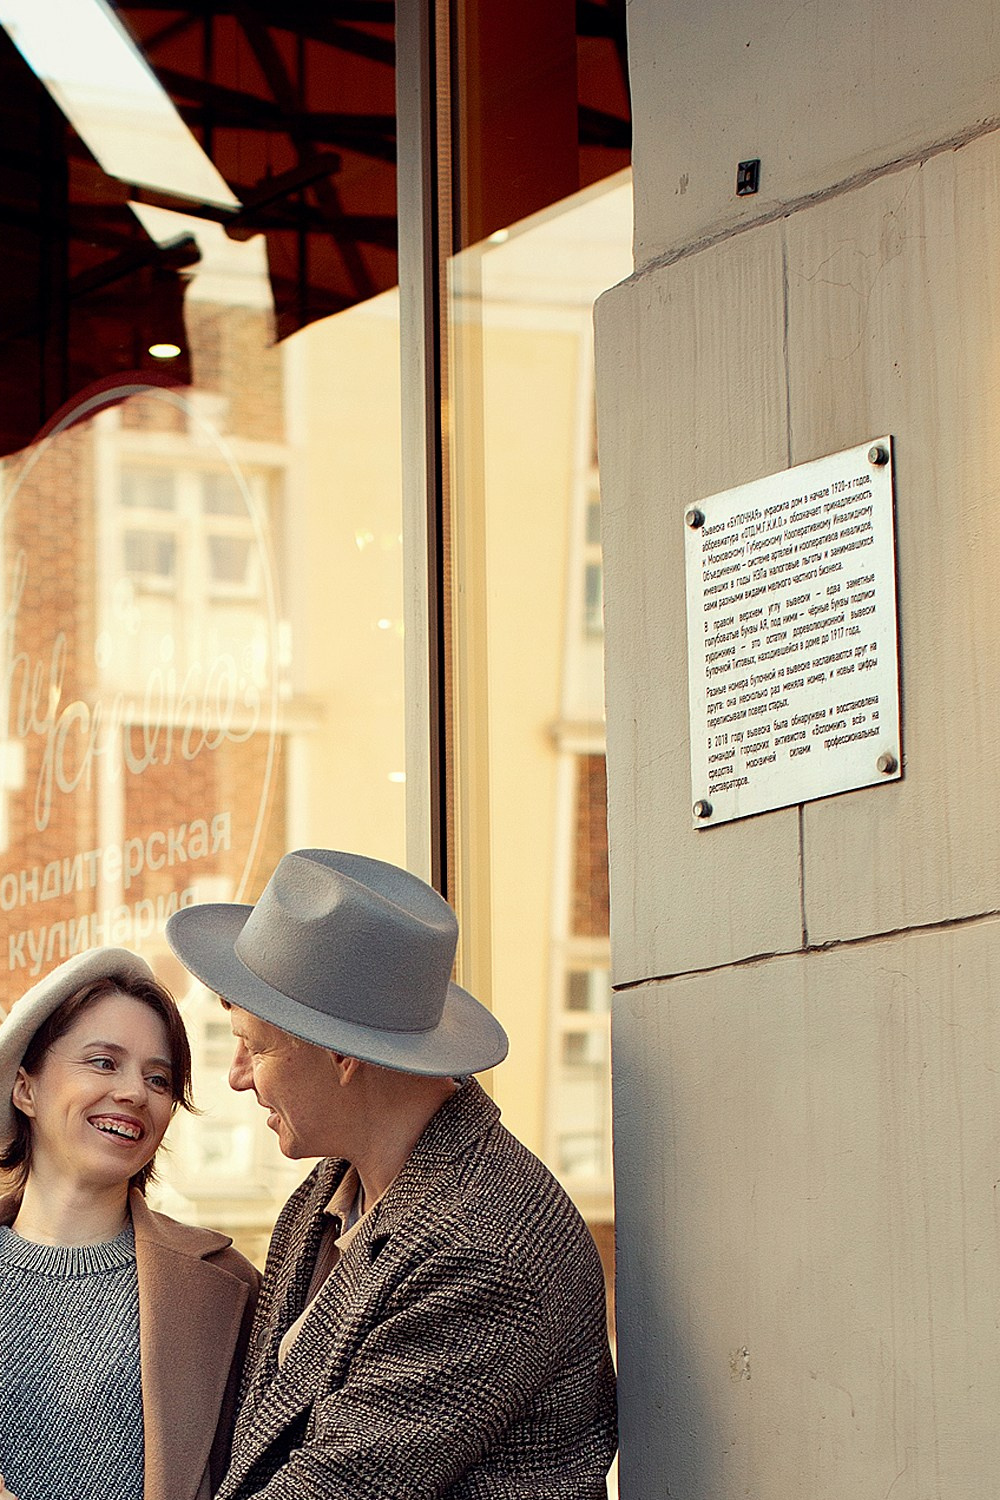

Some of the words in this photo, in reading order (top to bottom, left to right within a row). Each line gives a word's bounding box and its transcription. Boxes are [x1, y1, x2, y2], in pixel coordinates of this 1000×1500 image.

[701, 523, 725, 538] Вывеска
[727, 508, 762, 528] «БУЛОЧНАЯ»
[764, 501, 789, 519] украсила
[791, 497, 803, 509] дом
[810, 488, 829, 501] начале
[831, 480, 851, 494] 1920-х
[702, 533, 739, 552] аббревиатура
[790, 506, 822, 524] обозначает
[823, 490, 872, 512] принадлежность
[708, 547, 745, 564] Московскому
[746, 534, 782, 555] Губернскому
[784, 519, 831, 540] Кооперативному
[833, 505, 873, 525] Инвалидному
[703, 563, 741, 582] Объединению
[748, 553, 770, 568] системе
[771, 543, 793, 562] артелей
[799, 531, 838, 551] кооперативов
[840, 521, 873, 538] инвалидов,
[703, 582, 728, 596] имевших
[736, 575, 751, 586] годы
[753, 567, 767, 581] НЭПа
[769, 559, 800, 576] налоговые
[802, 553, 822, 566] льготы
[830, 536, 874, 557] занимавшихся
[704, 600, 718, 612] сами
[719, 592, 744, 610] разными
[745, 585, 766, 599] видами
[767, 577, 791, 592] мелкого
[792, 569, 818, 584] частного
[713, 616, 734, 631] правом
[739, 608, 763, 622] верхнем
[768, 602, 781, 616] углу
[786, 593, 811, 608] вывески
[826, 584, 841, 595] едва
[846, 573, 875, 590] заметные
[704, 630, 739, 647] голубоватые
[741, 624, 758, 639] буквы
[770, 617, 781, 627] под
[783, 612, 798, 624] ними
[808, 602, 829, 617] чёрные
[831, 597, 849, 612] буквы
[851, 589, 876, 603] подписи
[751, 639, 761, 649] это
[766, 631, 787, 644] остатки
[793, 611, 845, 638] дореволюционной
[851, 605, 876, 620] вывески
[706, 660, 731, 679] булочной
[732, 656, 756, 669] Титовых,
[758, 642, 799, 661] находившейся
[805, 636, 820, 650] доме
[821, 634, 829, 645] до
[830, 626, 844, 640] 1917
[706, 685, 726, 698] Разные
[728, 678, 749, 692] номера
[750, 668, 776, 686] булочной
[778, 668, 785, 678] на
[786, 661, 811, 675] вывеске
[812, 649, 853, 668] наслаиваются
[854, 644, 868, 657] друг
[870, 642, 877, 651] на
[727, 697, 737, 707] она
[739, 688, 768, 704] несколько
[770, 685, 780, 698] раз
[783, 678, 804, 691] меняла
[807, 672, 827, 685] номер,
[836, 664, 855, 676] новые
[858, 658, 878, 671] цифры
[707, 710, 747, 728] переписывали
[748, 704, 767, 716] поверх
[768, 698, 789, 711] старых.
[708, 746, 735, 764] командой
[740, 740, 769, 755] городских
[774, 730, 806, 746] активистов
[812, 720, 847, 736] «Вспомнить
[852, 712, 866, 726] всё»
[872, 711, 879, 720] на
[715, 733, 728, 747] 2018
[731, 732, 744, 743] году
[747, 724, 771, 739] вывеска
[773, 719, 788, 731] была
[791, 709, 826, 726] обнаружена
[836, 695, 879, 714] восстановлена
[708, 765, 733, 779] средства
[746, 751, 776, 769] москвичей
[789, 745, 811, 758] силами
[824, 726, 880, 750] профессиональных
[709, 776, 750, 796] реставраторов.
